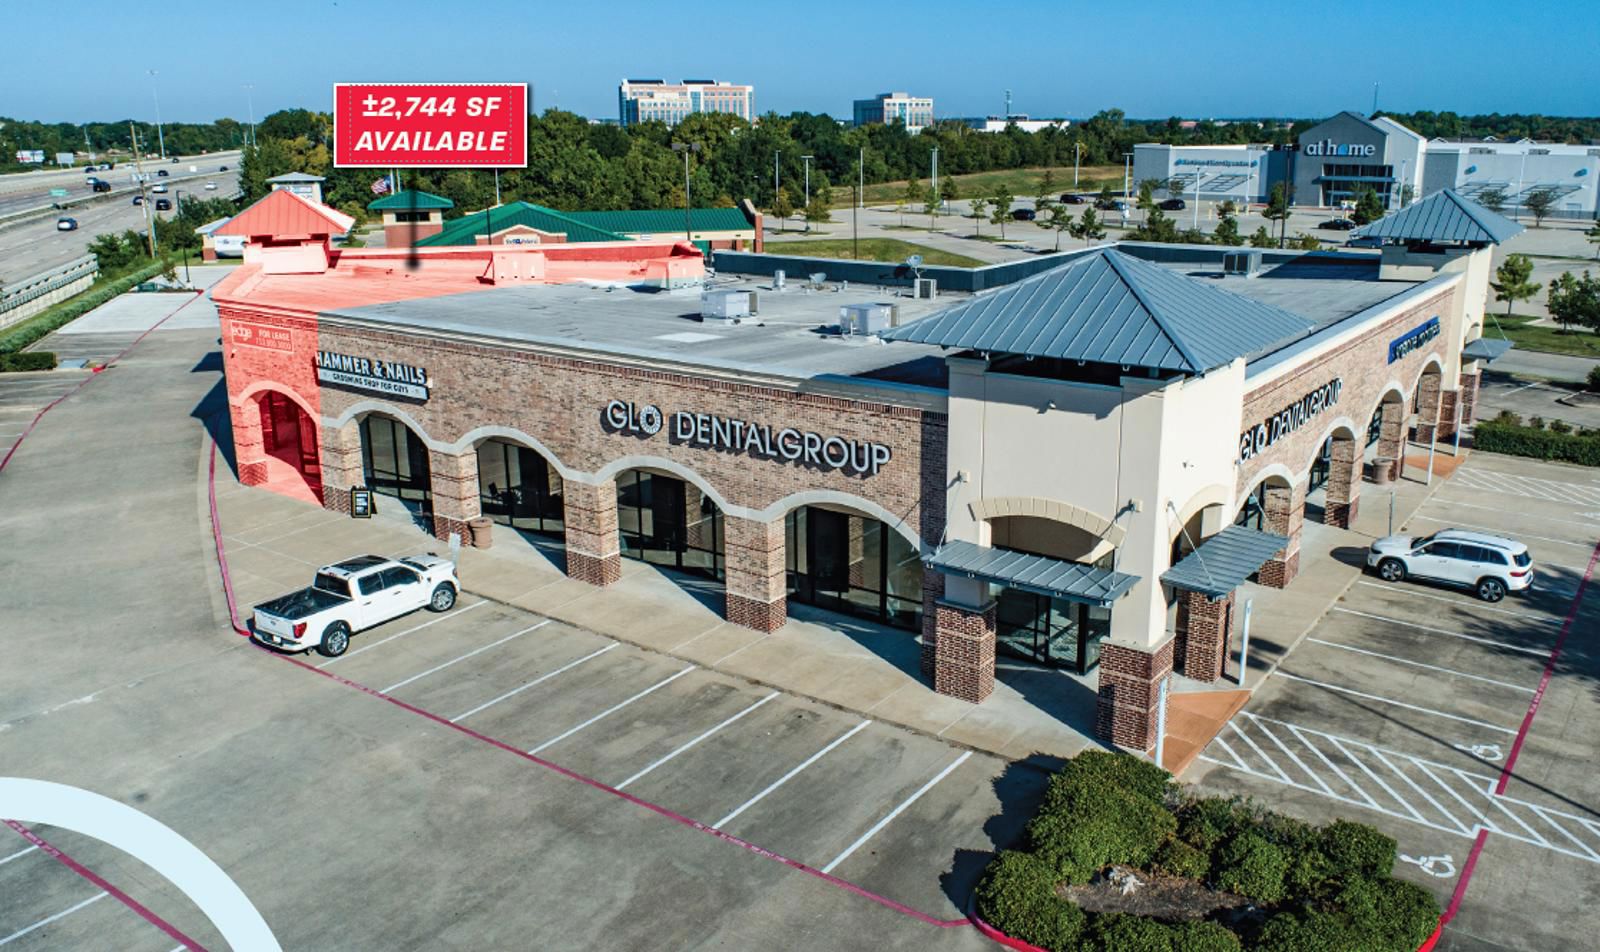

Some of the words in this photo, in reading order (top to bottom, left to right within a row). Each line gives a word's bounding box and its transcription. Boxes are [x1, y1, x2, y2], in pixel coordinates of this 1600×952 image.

[1306, 140, 1324, 156] at
[258, 329, 271, 339] FOR
[271, 331, 290, 341] LEASE
[315, 351, 371, 375] HAMMER
[373, 360, 383, 377] &
[386, 362, 426, 385] NAILS
[332, 373, 362, 385] GROOMING
[364, 378, 380, 388] SHOP
[380, 382, 393, 390] FOR
[393, 385, 409, 394] GUYS
[1239, 423, 1265, 464] GLO
[1271, 377, 1343, 447] DENTALGROUP
[606, 400, 662, 435] GLO
[676, 411, 891, 475] DENTALGROUP
